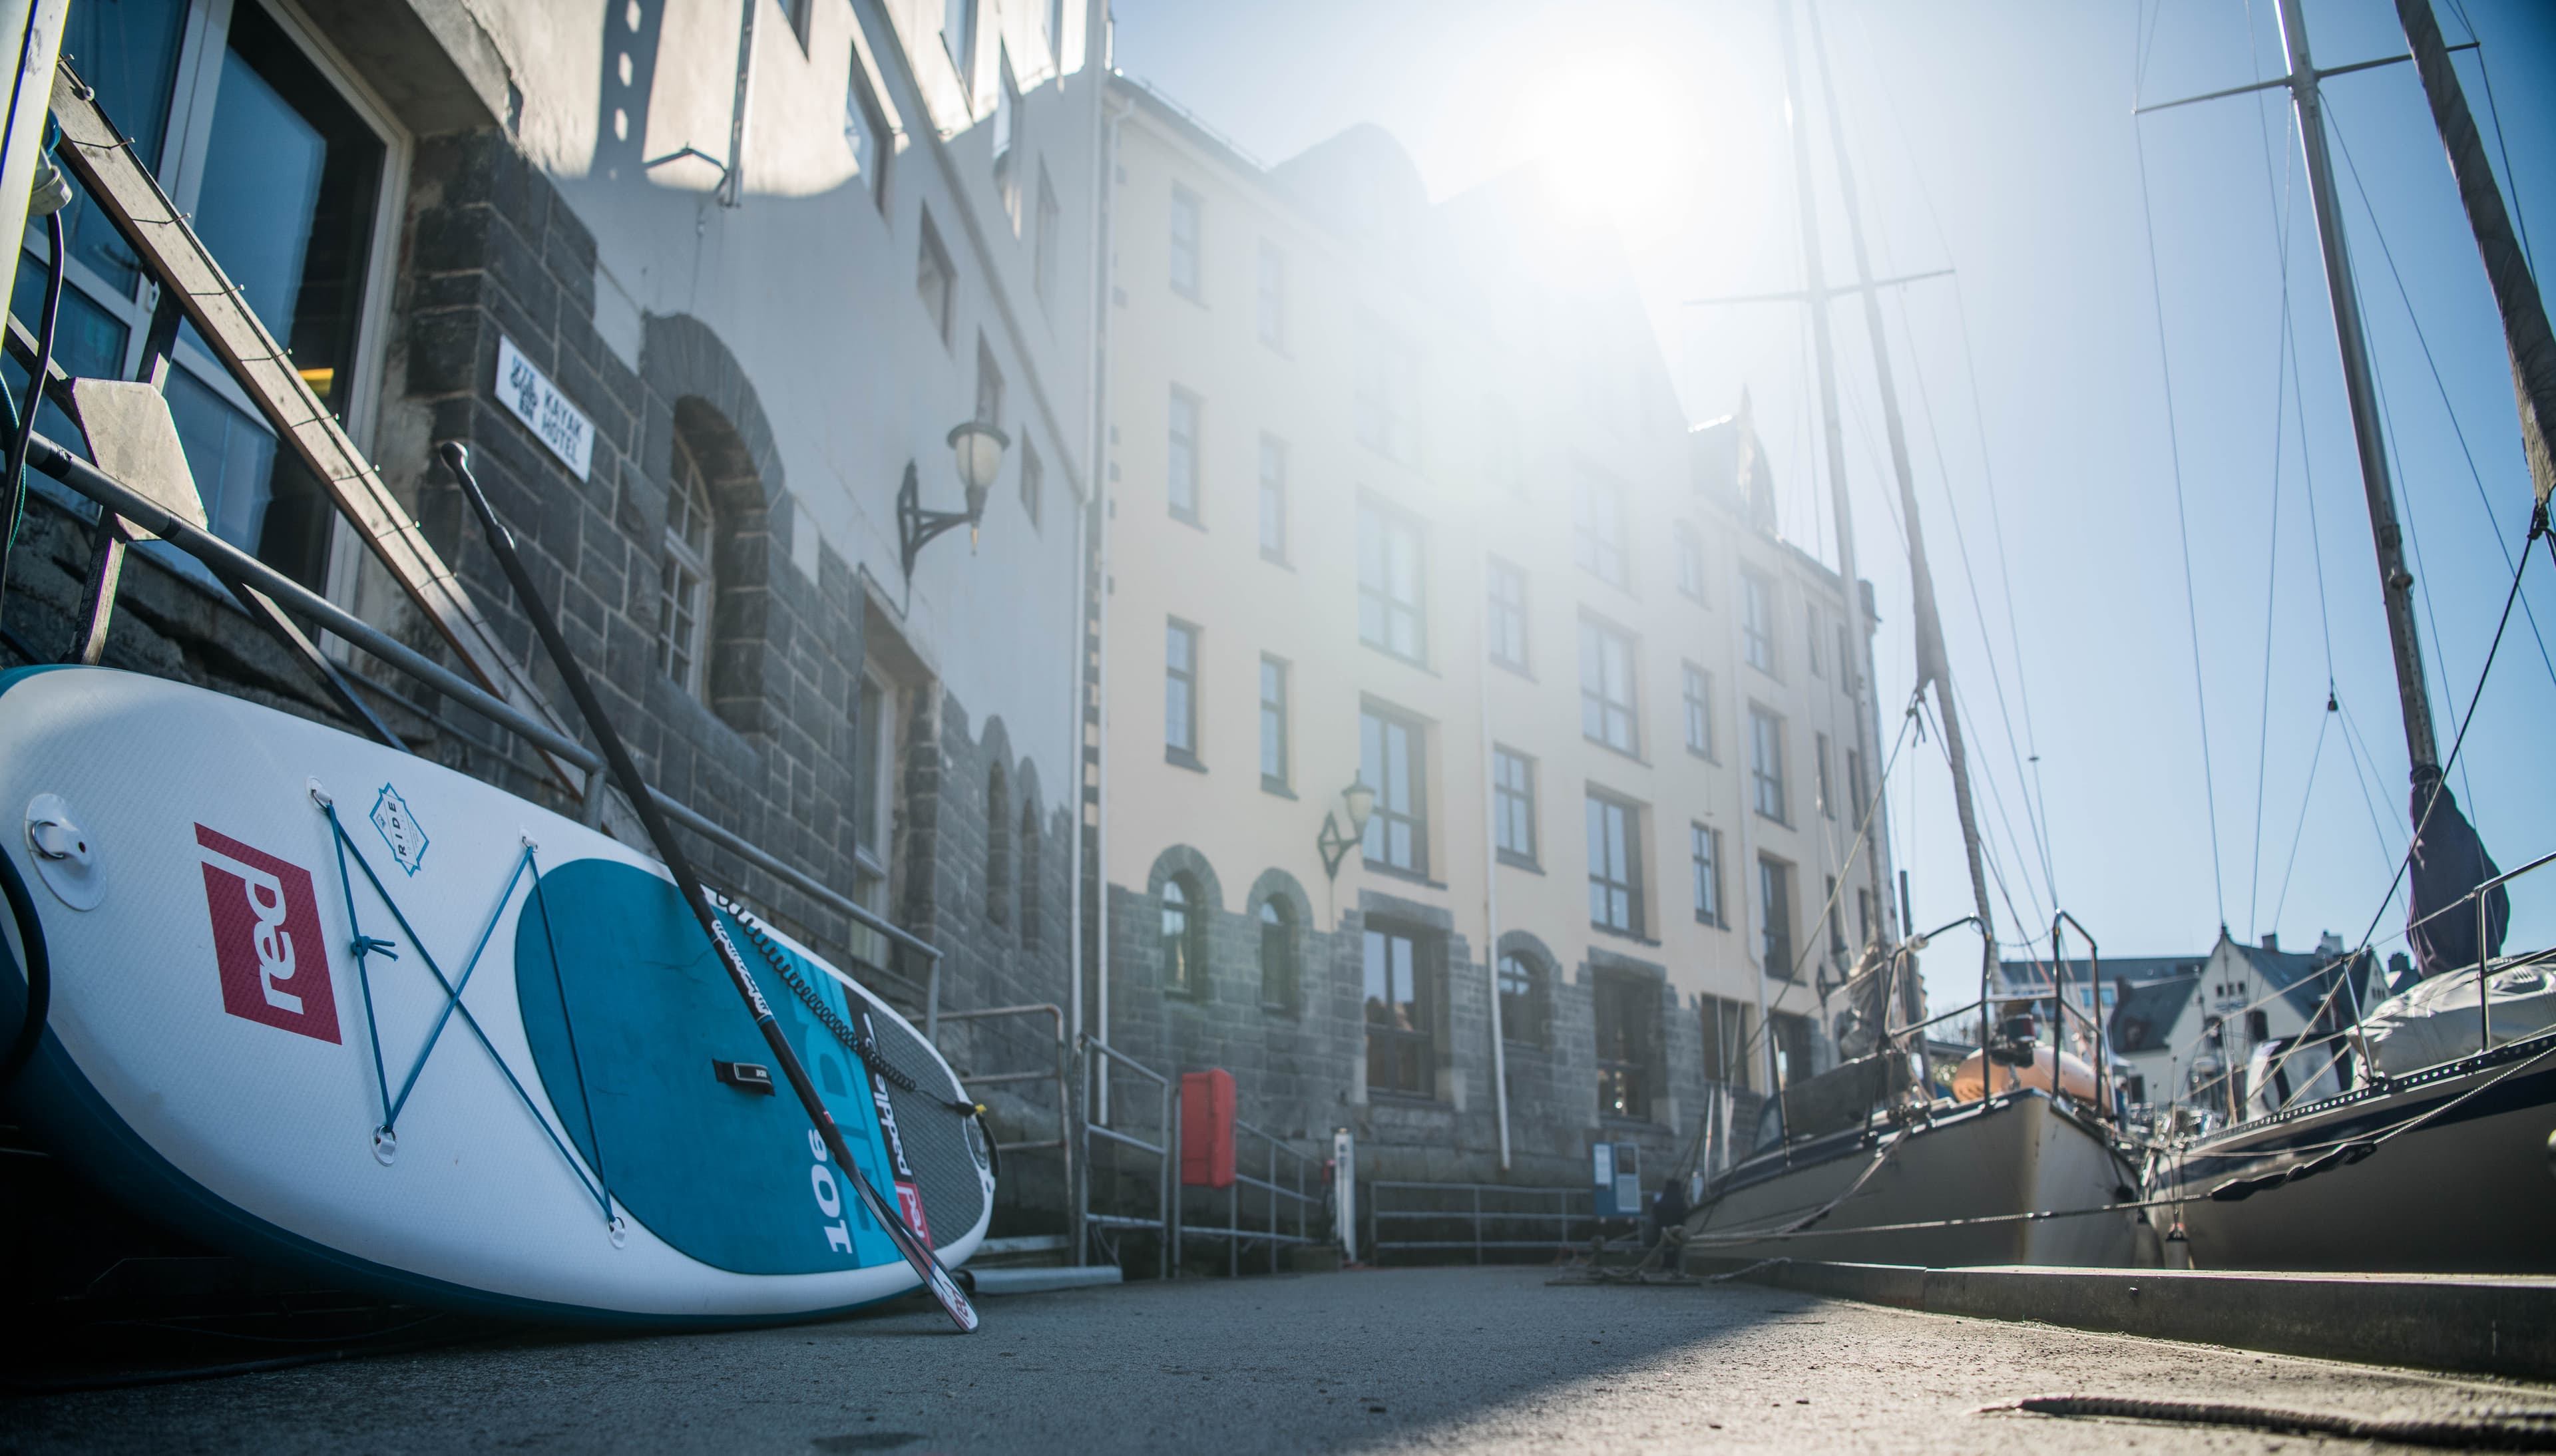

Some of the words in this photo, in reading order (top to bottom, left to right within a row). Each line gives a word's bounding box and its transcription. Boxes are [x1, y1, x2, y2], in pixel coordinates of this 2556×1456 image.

[541, 412, 577, 465] HOTEL
[387, 801, 407, 856] RIDE
[198, 842, 304, 1015] red
[873, 1073, 913, 1177] paddle
[895, 1185, 926, 1238] red
